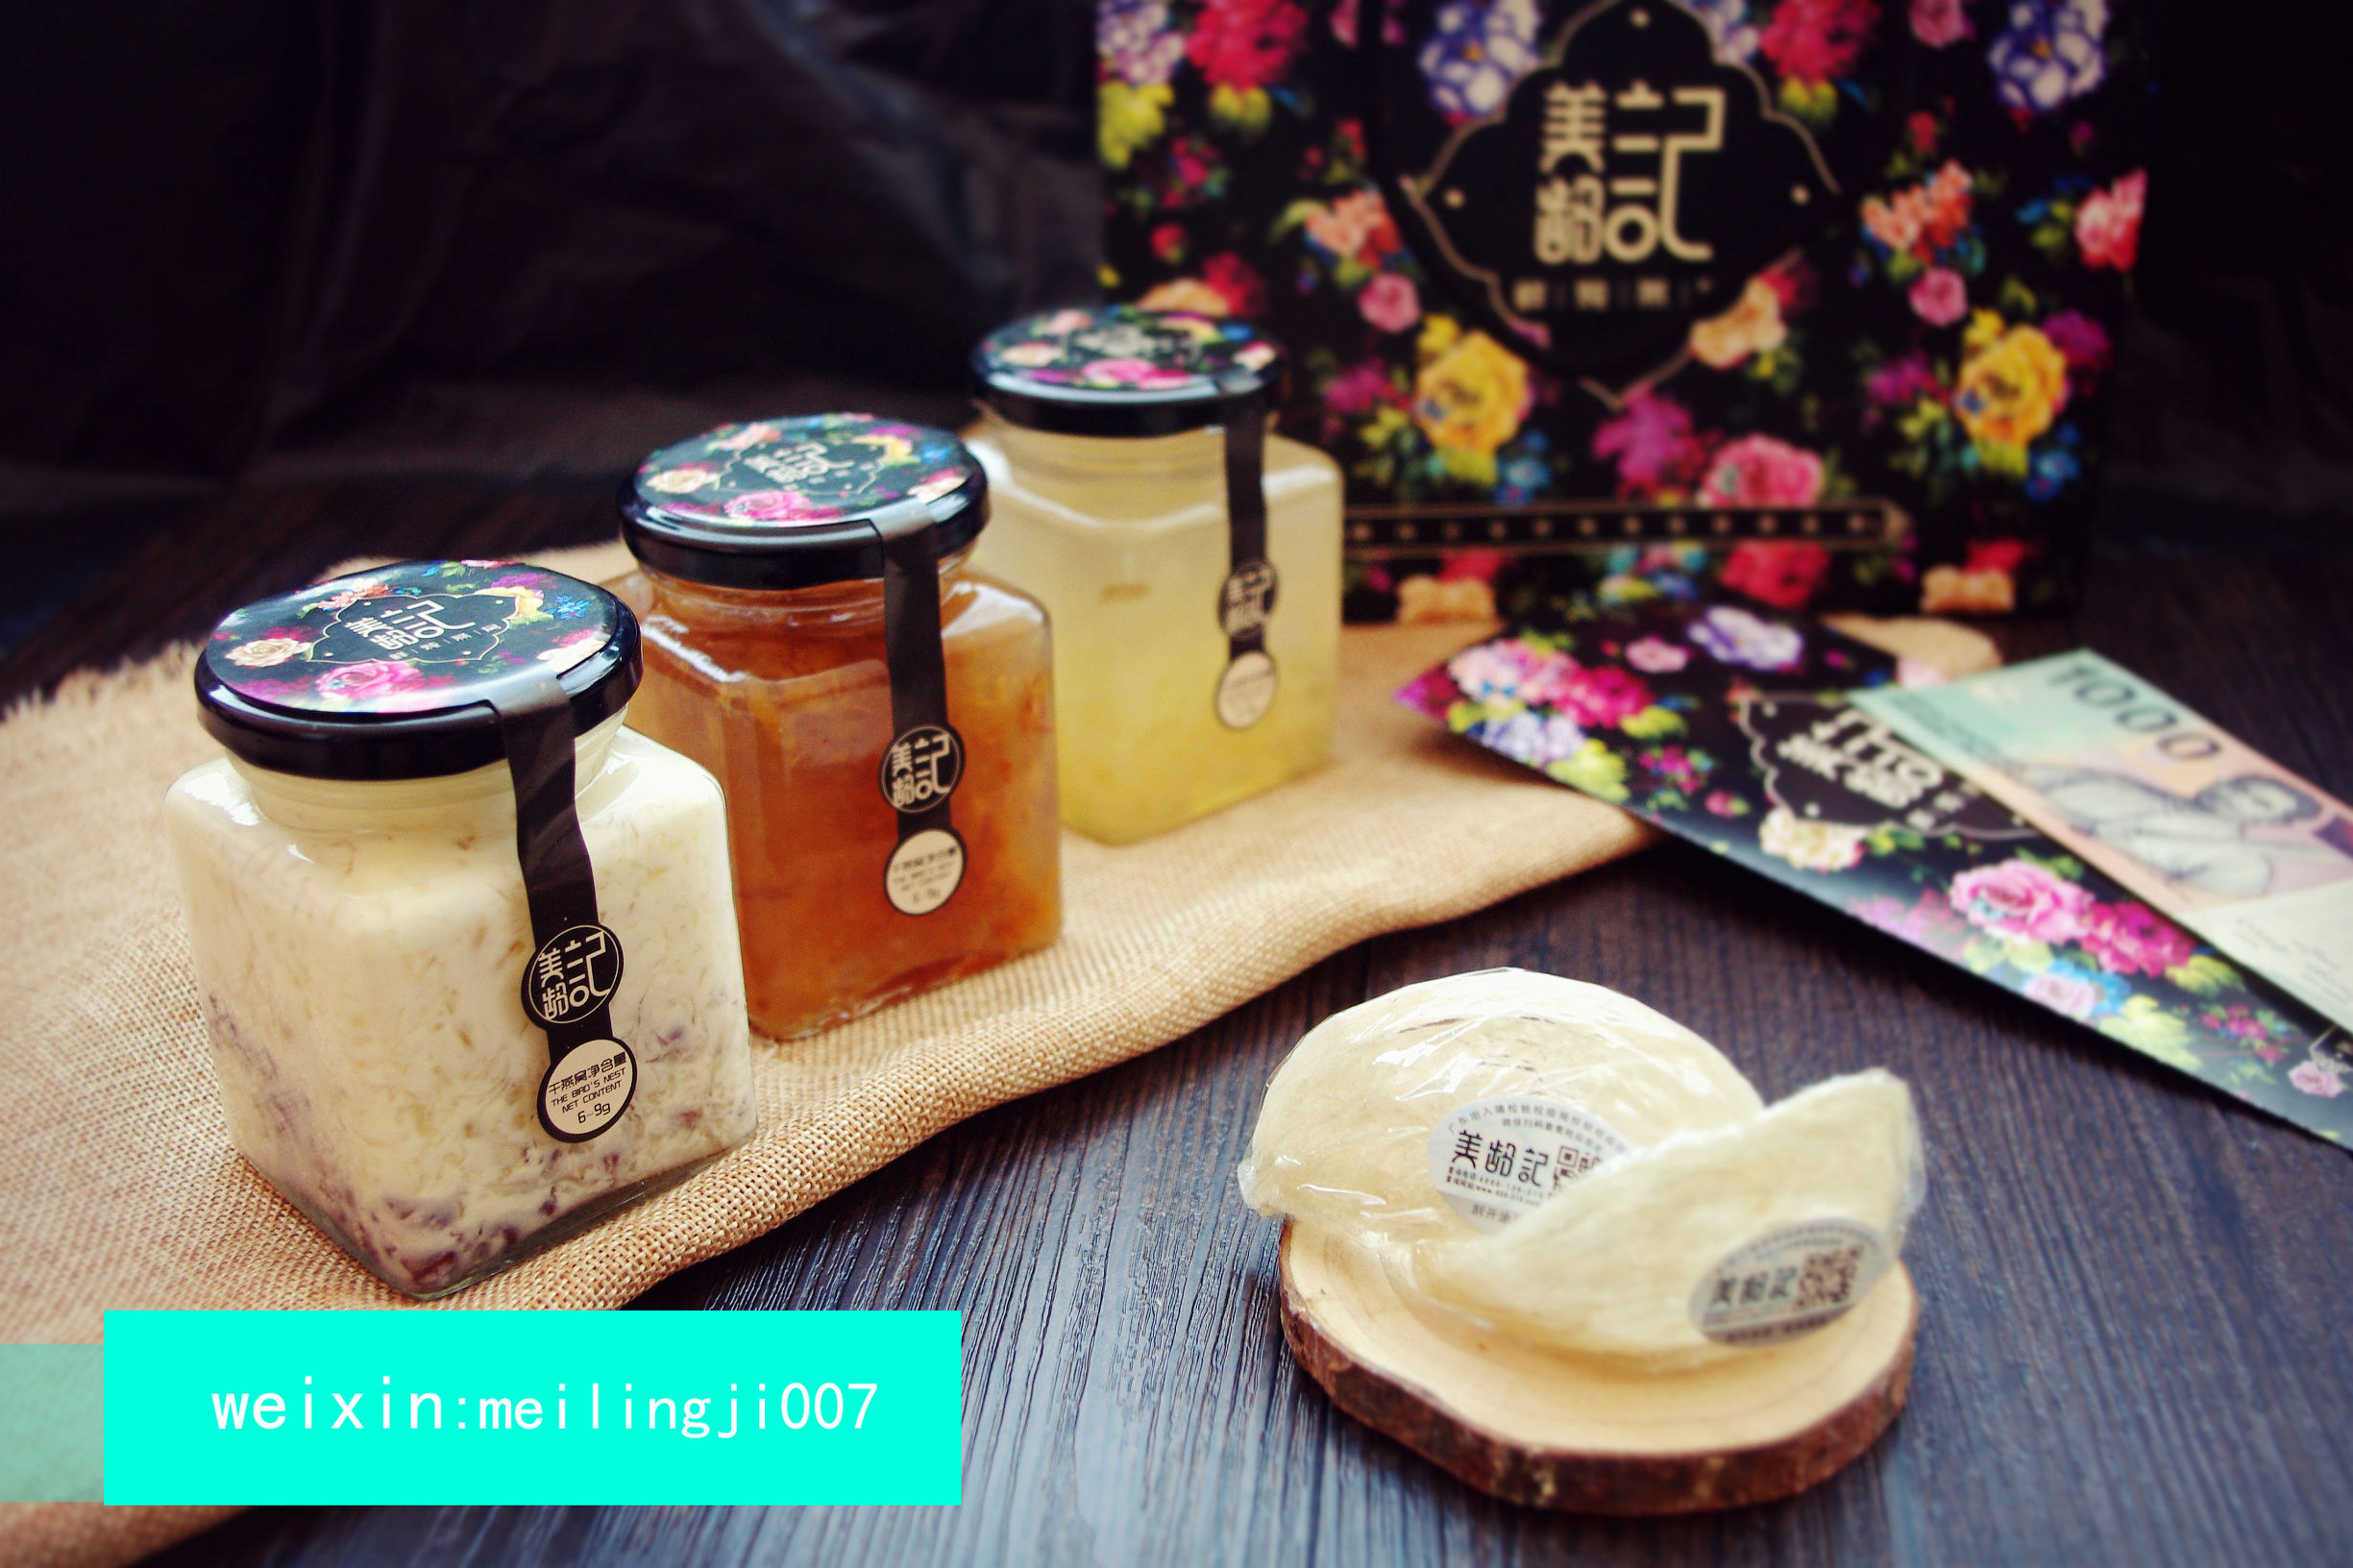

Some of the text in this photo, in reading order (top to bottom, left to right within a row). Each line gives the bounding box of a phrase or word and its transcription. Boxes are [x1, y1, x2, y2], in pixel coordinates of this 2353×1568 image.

[551, 1067, 626, 1107] THE BIRD'S NEST
[562, 1080, 622, 1114] NET CONTENT
